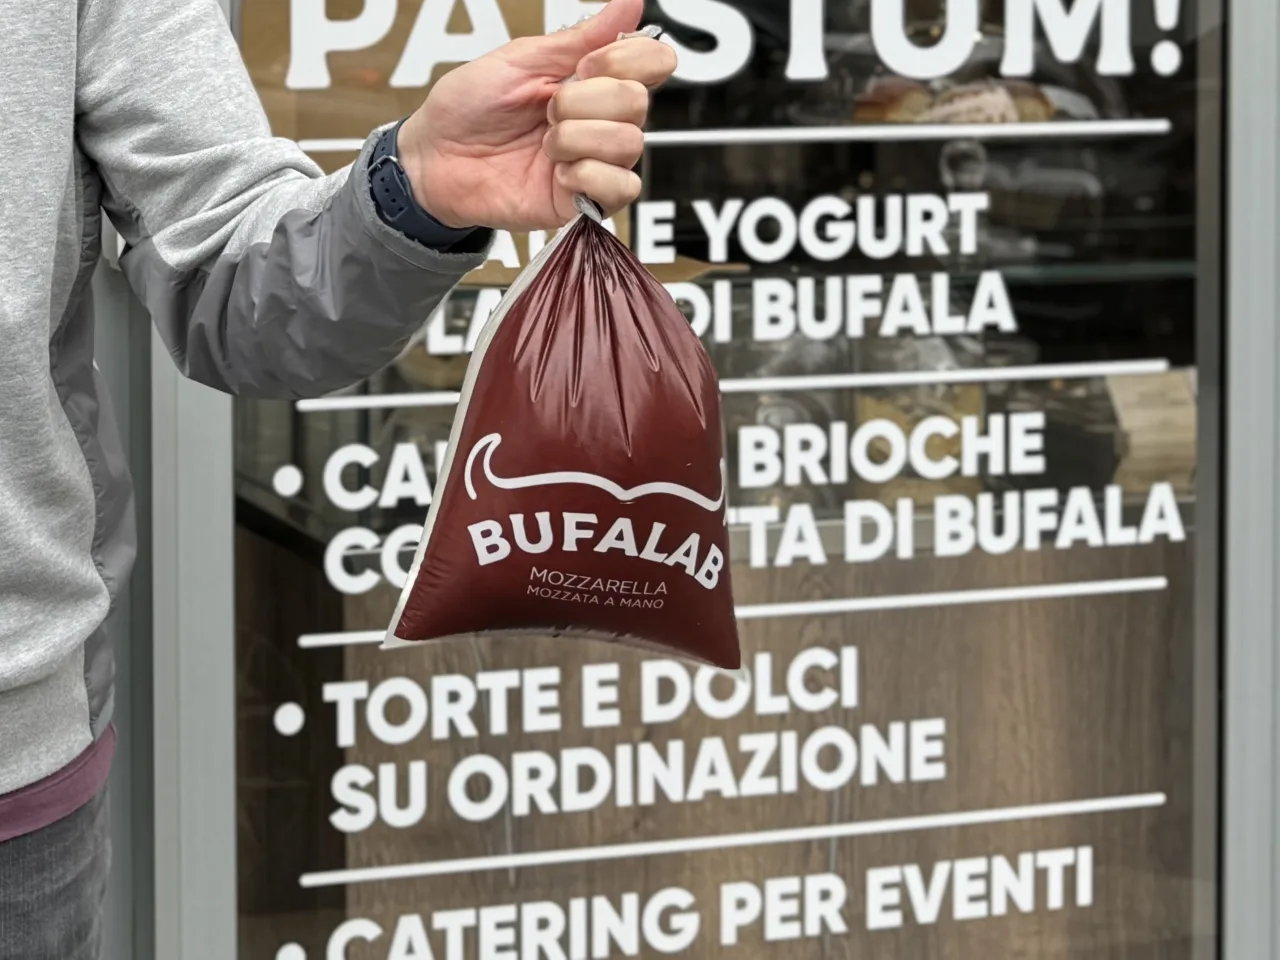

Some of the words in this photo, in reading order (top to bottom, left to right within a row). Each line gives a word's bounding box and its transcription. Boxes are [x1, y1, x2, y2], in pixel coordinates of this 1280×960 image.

[635, 200, 677, 265] E
[691, 191, 991, 264] YOGURT
[751, 269, 1019, 343] BUFALA
[736, 410, 1047, 489] BRIOCHE
[467, 511, 724, 590] BUFALAB
[843, 496, 914, 563] DI
[931, 480, 1188, 556] BUFALA
[526, 585, 600, 605] MOZZATA
[604, 596, 615, 606] A
[619, 597, 664, 609] MANO
[529, 566, 668, 596] MOZZARELLA
[322, 665, 563, 749] TORTE
[580, 661, 623, 730] E
[639, 644, 860, 725] DOLCI
[329, 758, 428, 834] SU
[447, 719, 947, 816] ORDINAZIONE
[325, 887, 702, 960] CATERING
[718, 871, 849, 948] PER
[864, 844, 1095, 932] EVENTI
